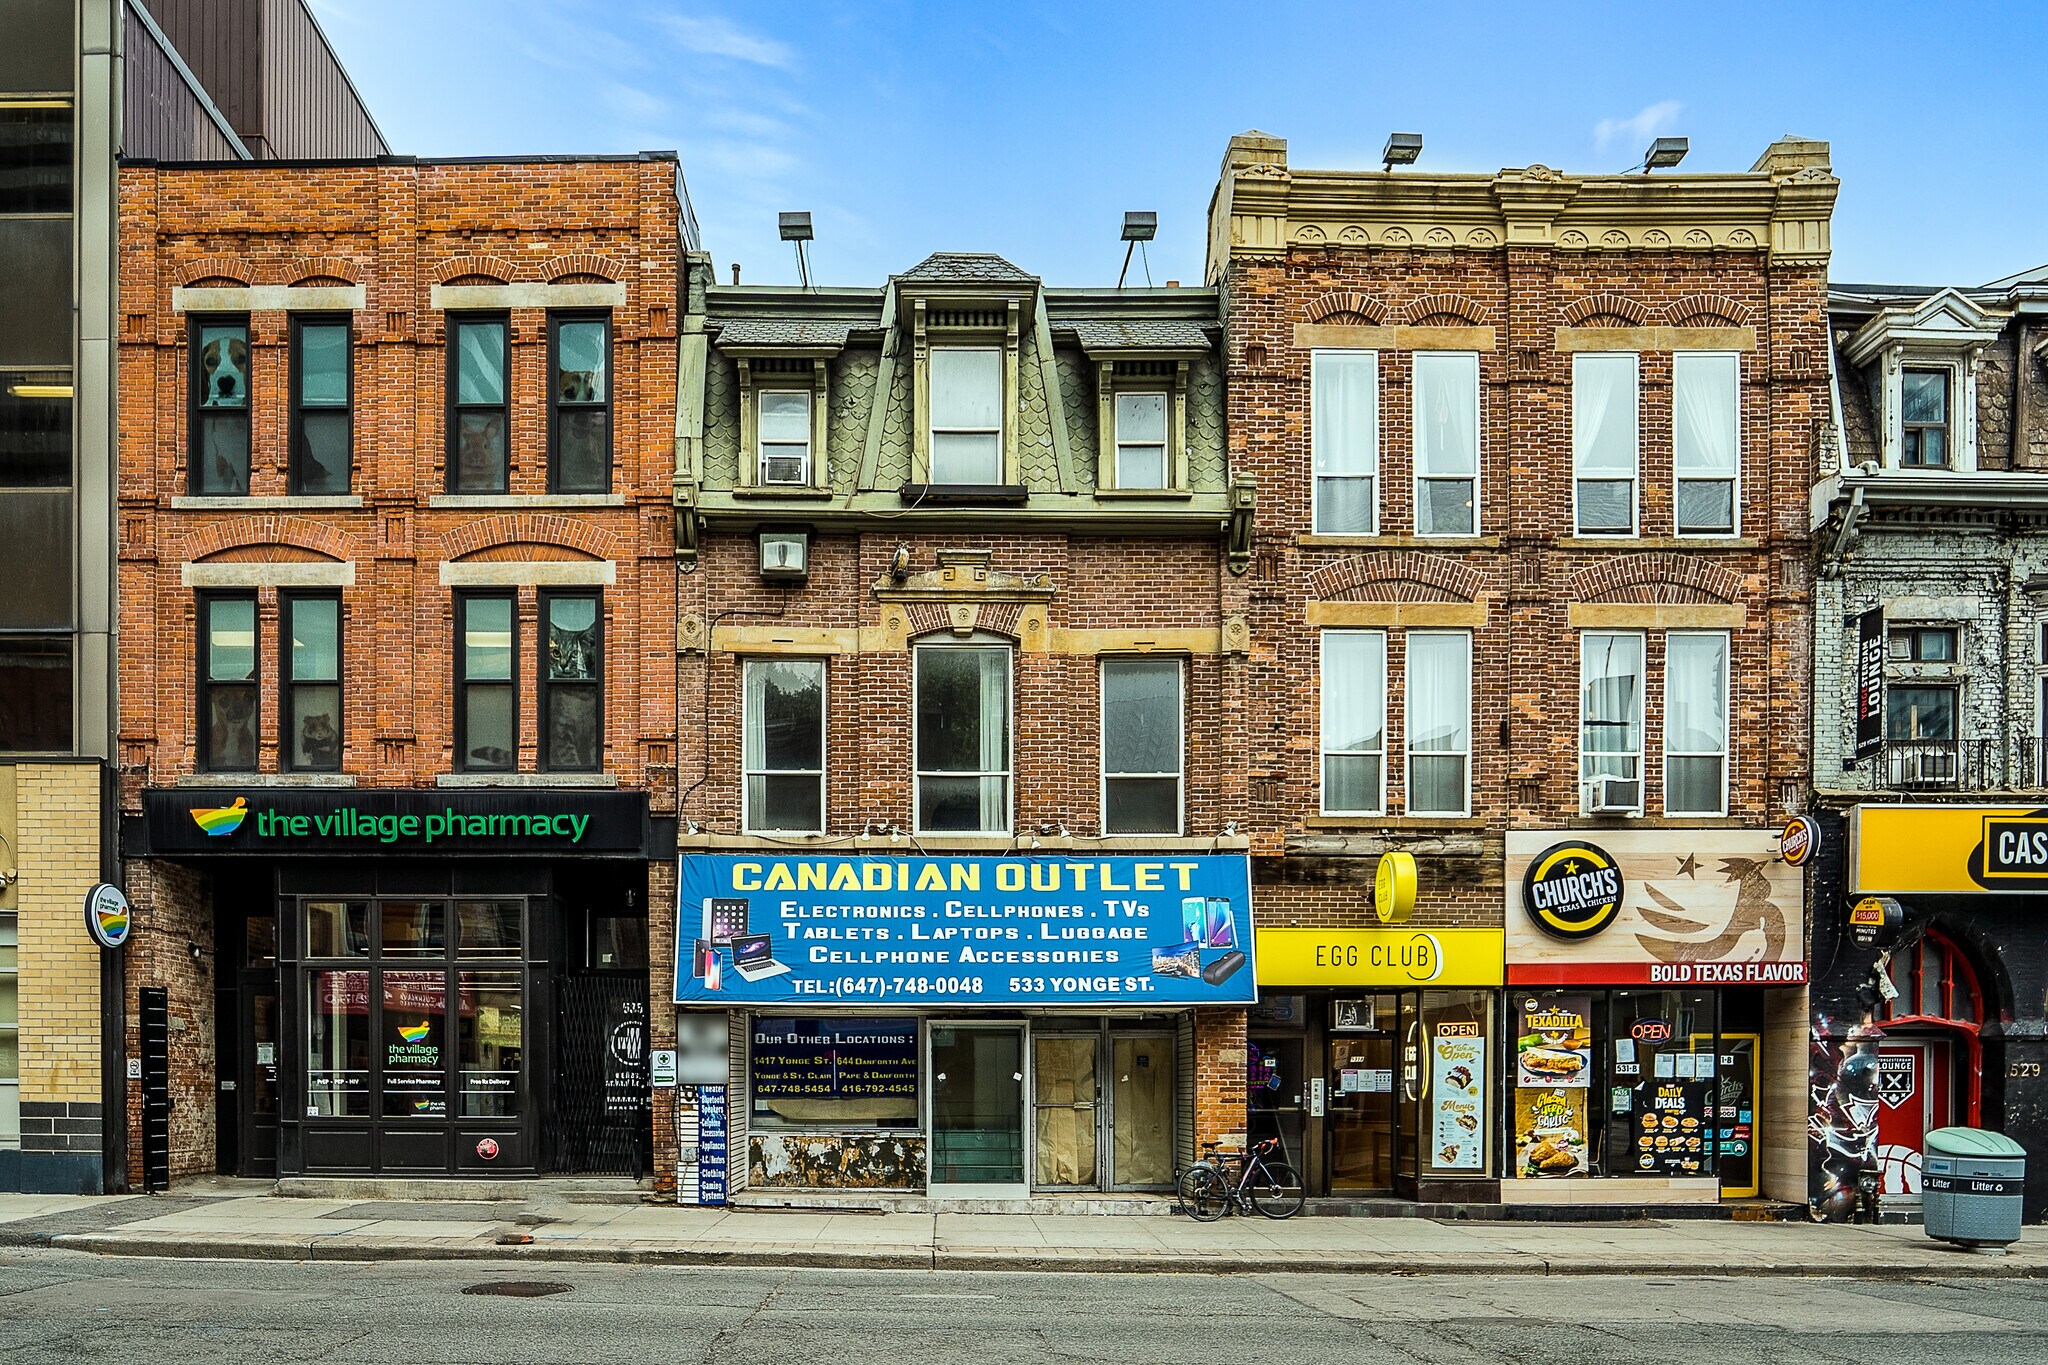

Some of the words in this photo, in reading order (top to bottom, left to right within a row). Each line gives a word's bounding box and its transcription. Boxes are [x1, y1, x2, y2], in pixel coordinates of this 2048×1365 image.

[1868, 635, 1881, 718] LOUNGE
[258, 808, 309, 836] the
[314, 808, 418, 843] village
[426, 808, 589, 843] pharmacy
[1783, 828, 1808, 853] CHURCH'S
[732, 863, 981, 891] CANADIAN
[996, 863, 1199, 891] OUTLET
[1532, 867, 1618, 909] CHURCH'S
[780, 901, 926, 918] ELECTRONICS
[945, 900, 1084, 918] CELLPHONES
[1557, 903, 1581, 914] TEXAS
[1587, 895, 1617, 908] CHICKEN
[1856, 911, 1879, 921] $15,000
[783, 923, 890, 940] TABLETS
[911, 923, 1019, 940] LAPTOPS
[1040, 922, 1148, 940] LUGGAGE
[809, 946, 950, 963] CELLPHONE
[958, 946, 1119, 963] ACCESSORIES
[1316, 945, 1358, 967] EGG
[1371, 945, 1428, 967] CLUB
[1651, 964, 1692, 982] BOLD
[1694, 963, 1743, 982] TEXAS
[1746, 963, 1804, 981] FLAVOR
[1009, 977, 1045, 992] 533
[1049, 977, 1120, 992] YONGE
[1124, 976, 1155, 992] ST.
[1525, 1014, 1584, 1028] TEXADILLA
[1440, 1025, 1476, 1037] OPEN
[1631, 1024, 1672, 1039] OPEN
[755, 1033, 782, 1044] OUR
[787, 1033, 831, 1044] OTHER
[835, 1033, 905, 1044] LOCATIONS
[388, 1044, 405, 1054] the
[406, 1044, 439, 1055] village
[388, 1053, 439, 1065] pharmacy
[754, 1056, 775, 1065] 1417
[778, 1056, 810, 1065] YONGE
[814, 1056, 832, 1065] ST.
[837, 1057, 854, 1065] 644
[1878, 1062, 1912, 1070] LOUNGE
[2010, 1063, 2041, 1077] 529
[758, 1085, 831, 1093] 647-748-5454
[842, 1085, 915, 1093] 416-792-4545
[1658, 1087, 1683, 1097] DAILY
[1441, 1100, 1475, 1113] Menu
[1655, 1097, 1685, 1109] DEALS
[701, 1105, 723, 1115] Speakers
[1537, 1115, 1569, 1128] GARLIC
[1932, 1179, 1951, 1188] Litter
[1972, 1181, 1994, 1191] Litter
[702, 1191, 724, 1202] Systems
